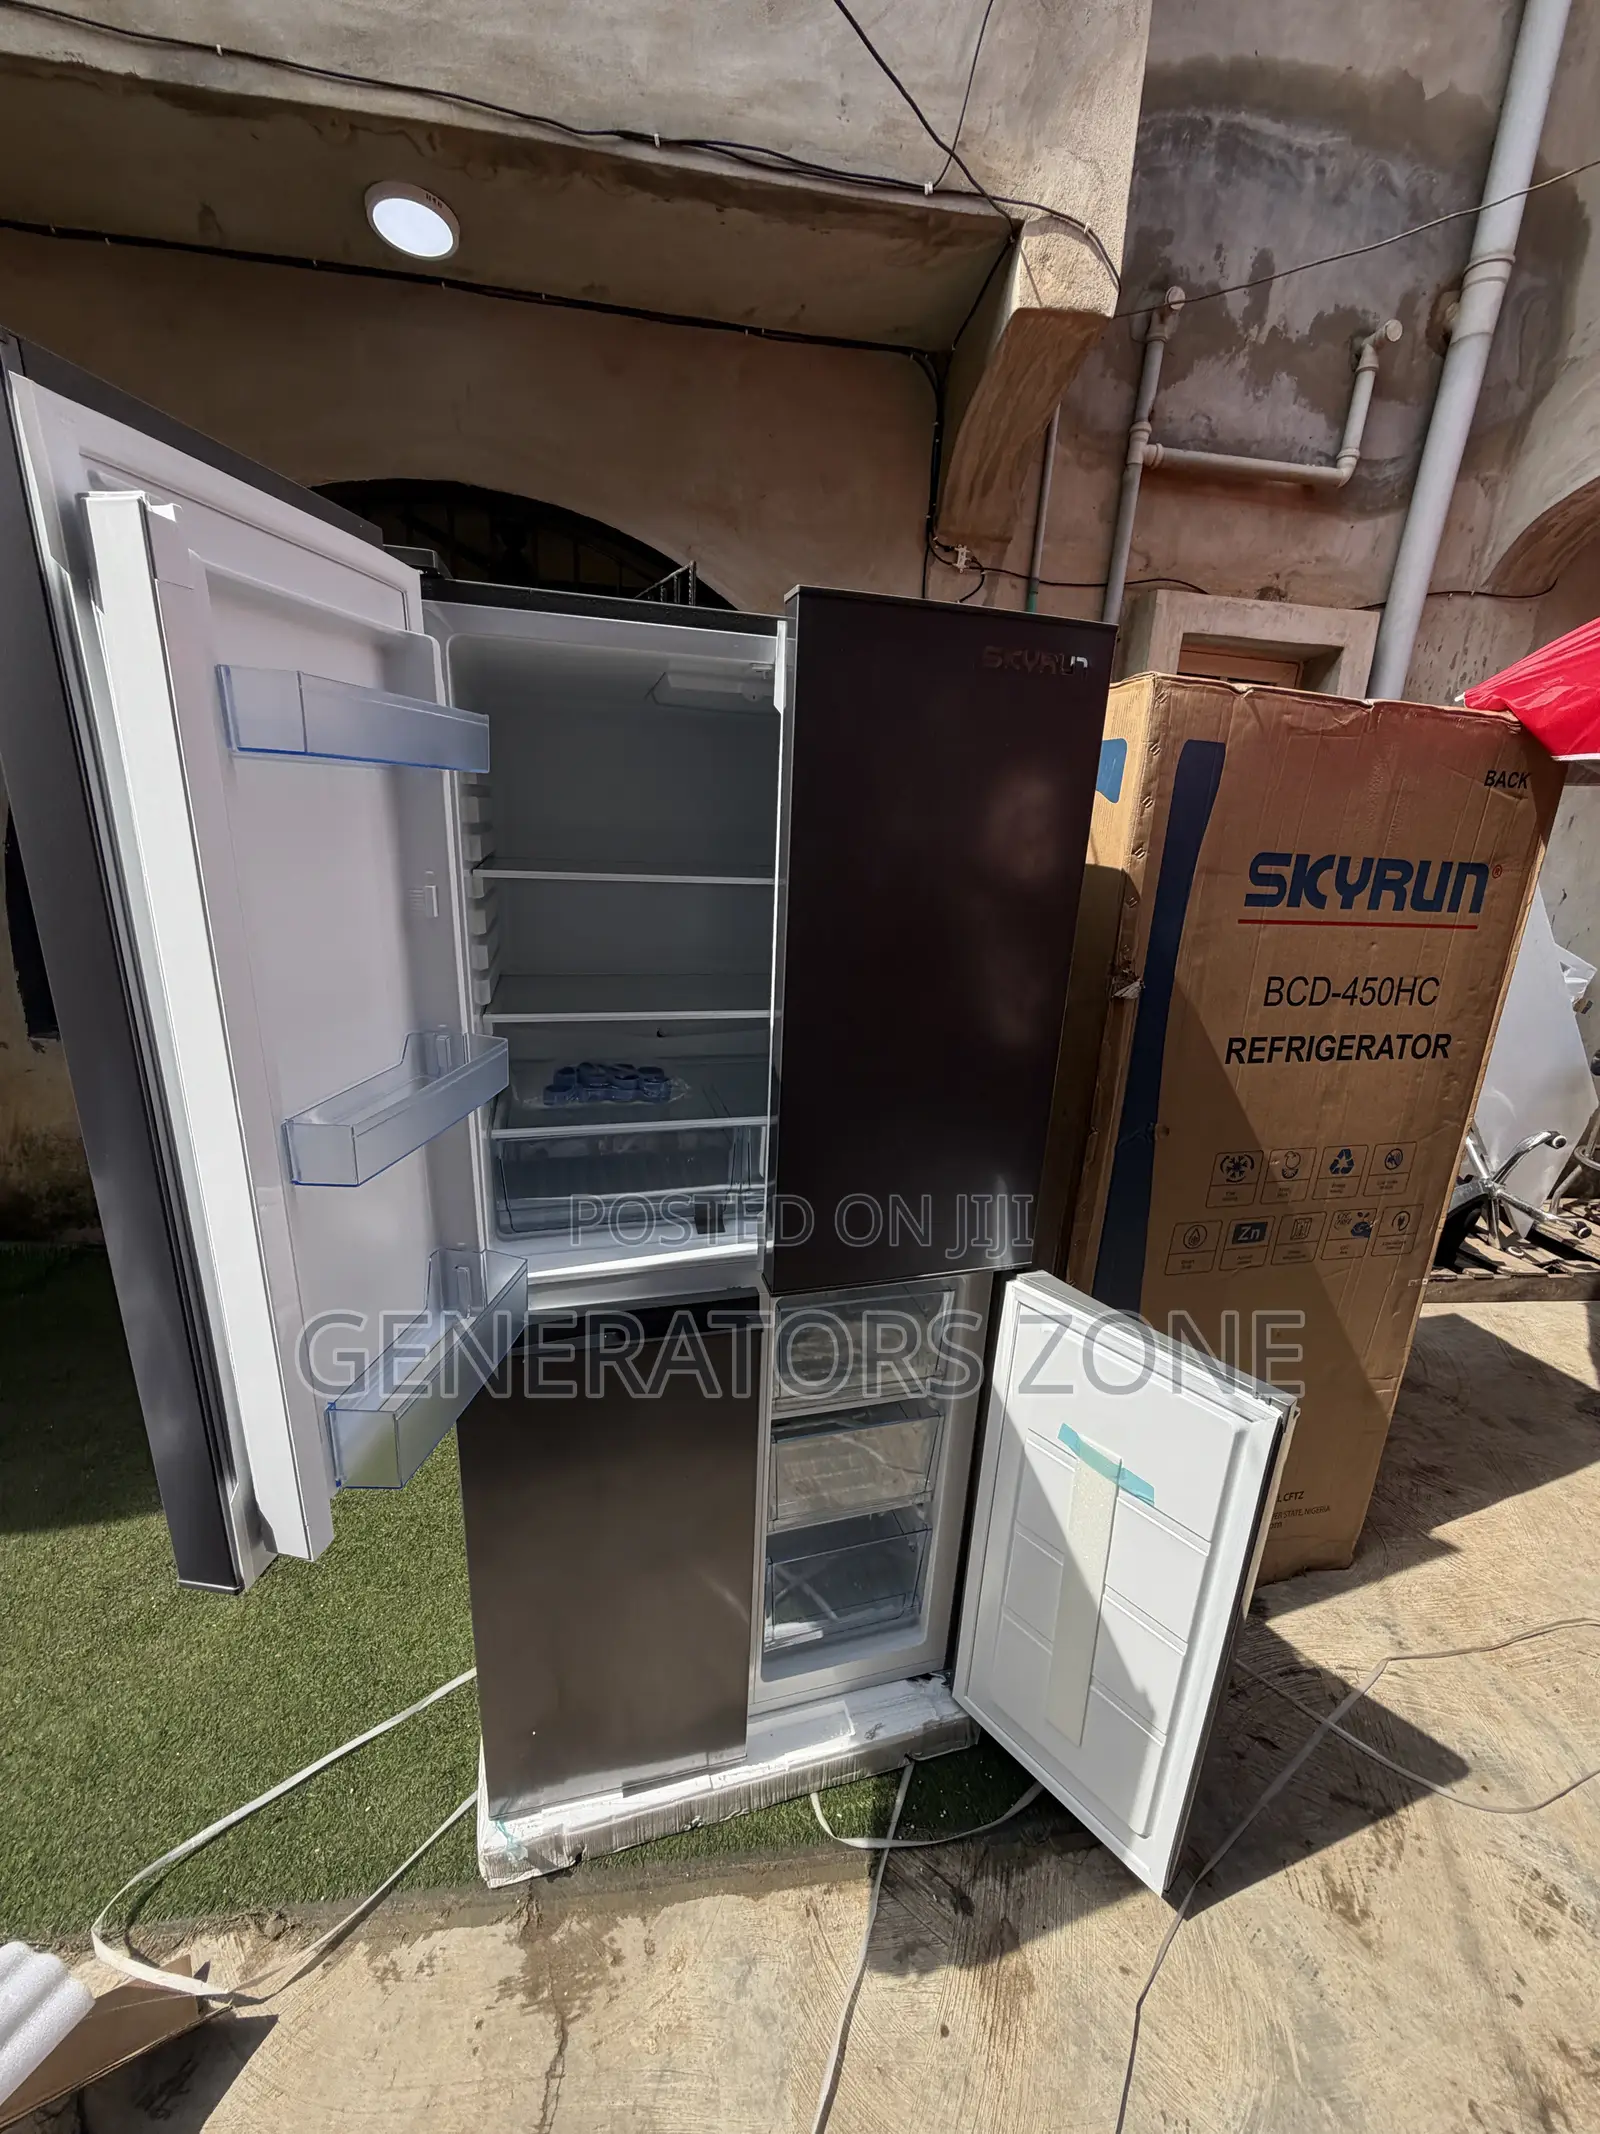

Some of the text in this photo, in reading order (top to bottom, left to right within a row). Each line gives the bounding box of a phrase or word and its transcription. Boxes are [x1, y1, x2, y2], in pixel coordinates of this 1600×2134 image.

[1484, 770, 1529, 789] BACK
[1263, 976, 1440, 1007] BCD-450HC
[1225, 1033, 1452, 1065] REFRIGERATOR
[1237, 1226, 1260, 1241] Zn
[1283, 1490, 1304, 1502] CFTZ
